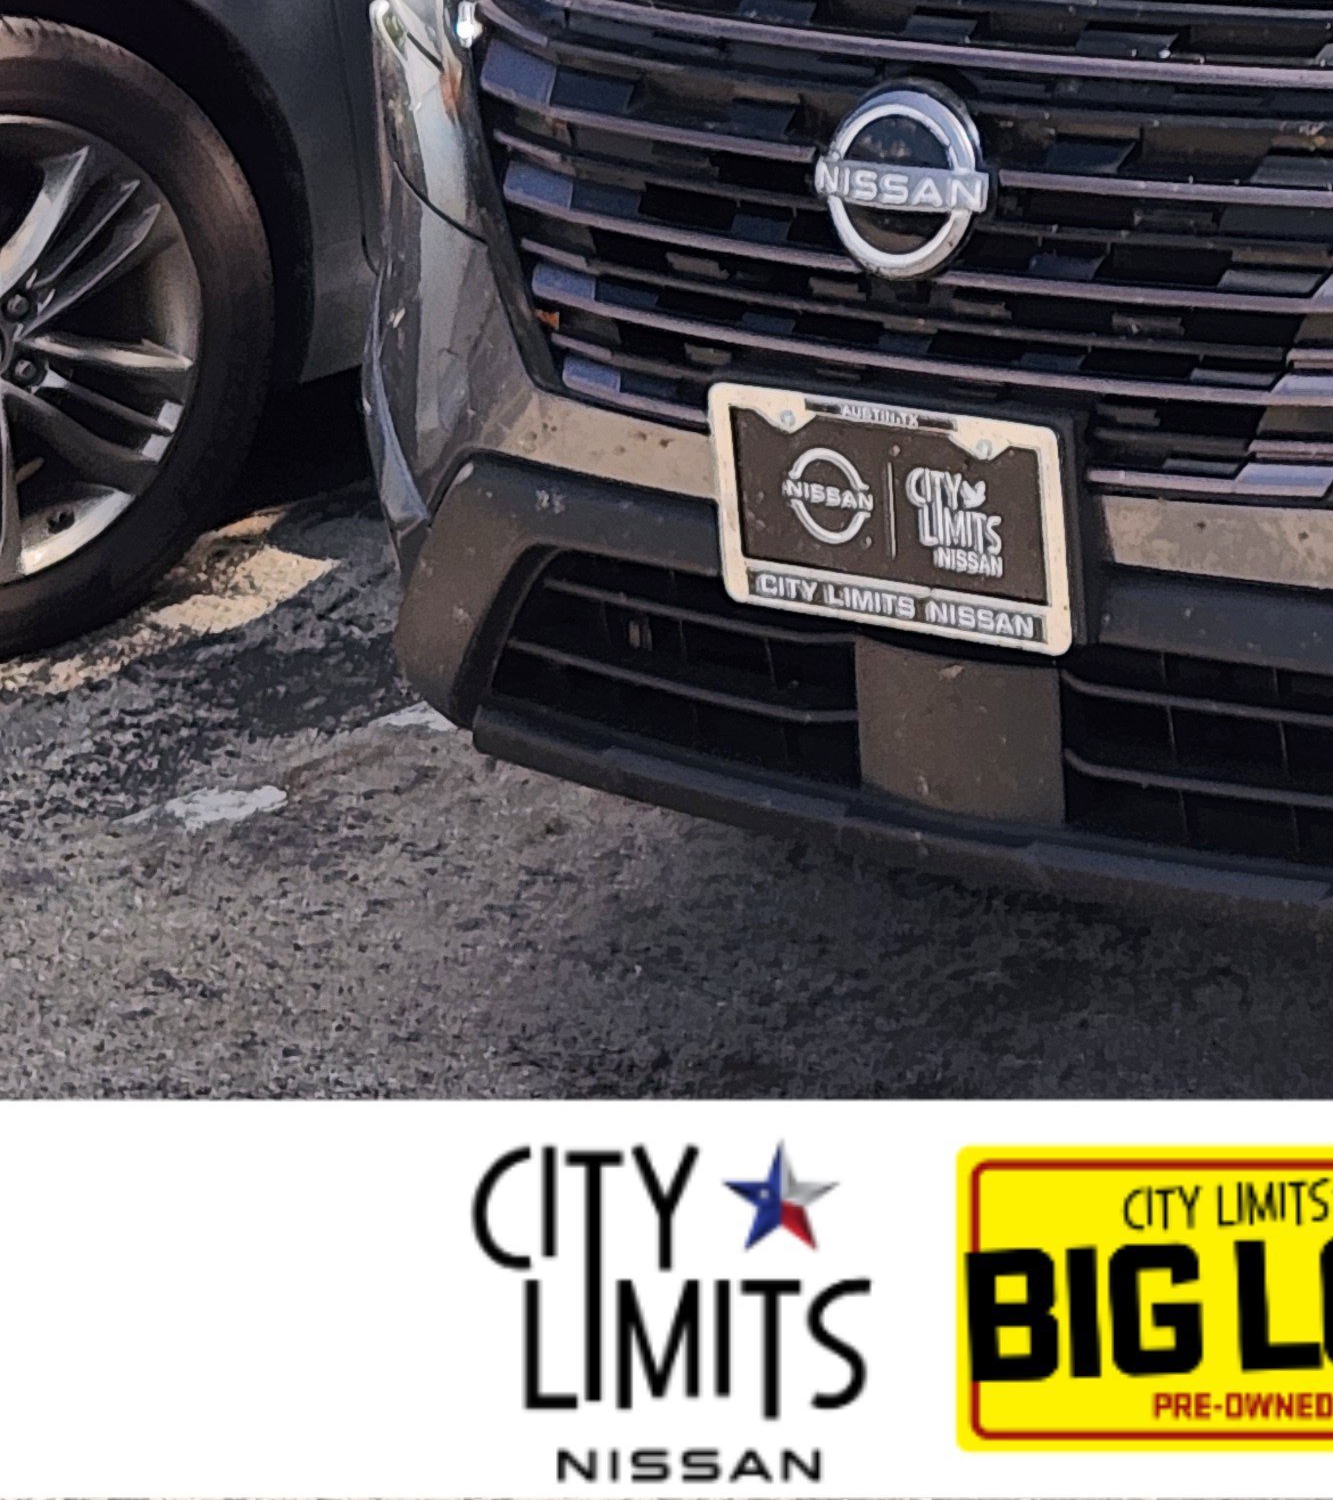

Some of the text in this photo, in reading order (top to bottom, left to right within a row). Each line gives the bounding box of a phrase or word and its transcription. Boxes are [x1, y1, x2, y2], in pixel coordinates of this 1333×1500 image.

[814, 160, 983, 208] NISSAN
[783, 477, 874, 512] NISSAN
[905, 466, 963, 509] CITY
[918, 504, 1003, 555] LIMITS
[933, 546, 1003, 578] NISSAN
[756, 572, 1036, 640] CITY LIMITS NISSAN
